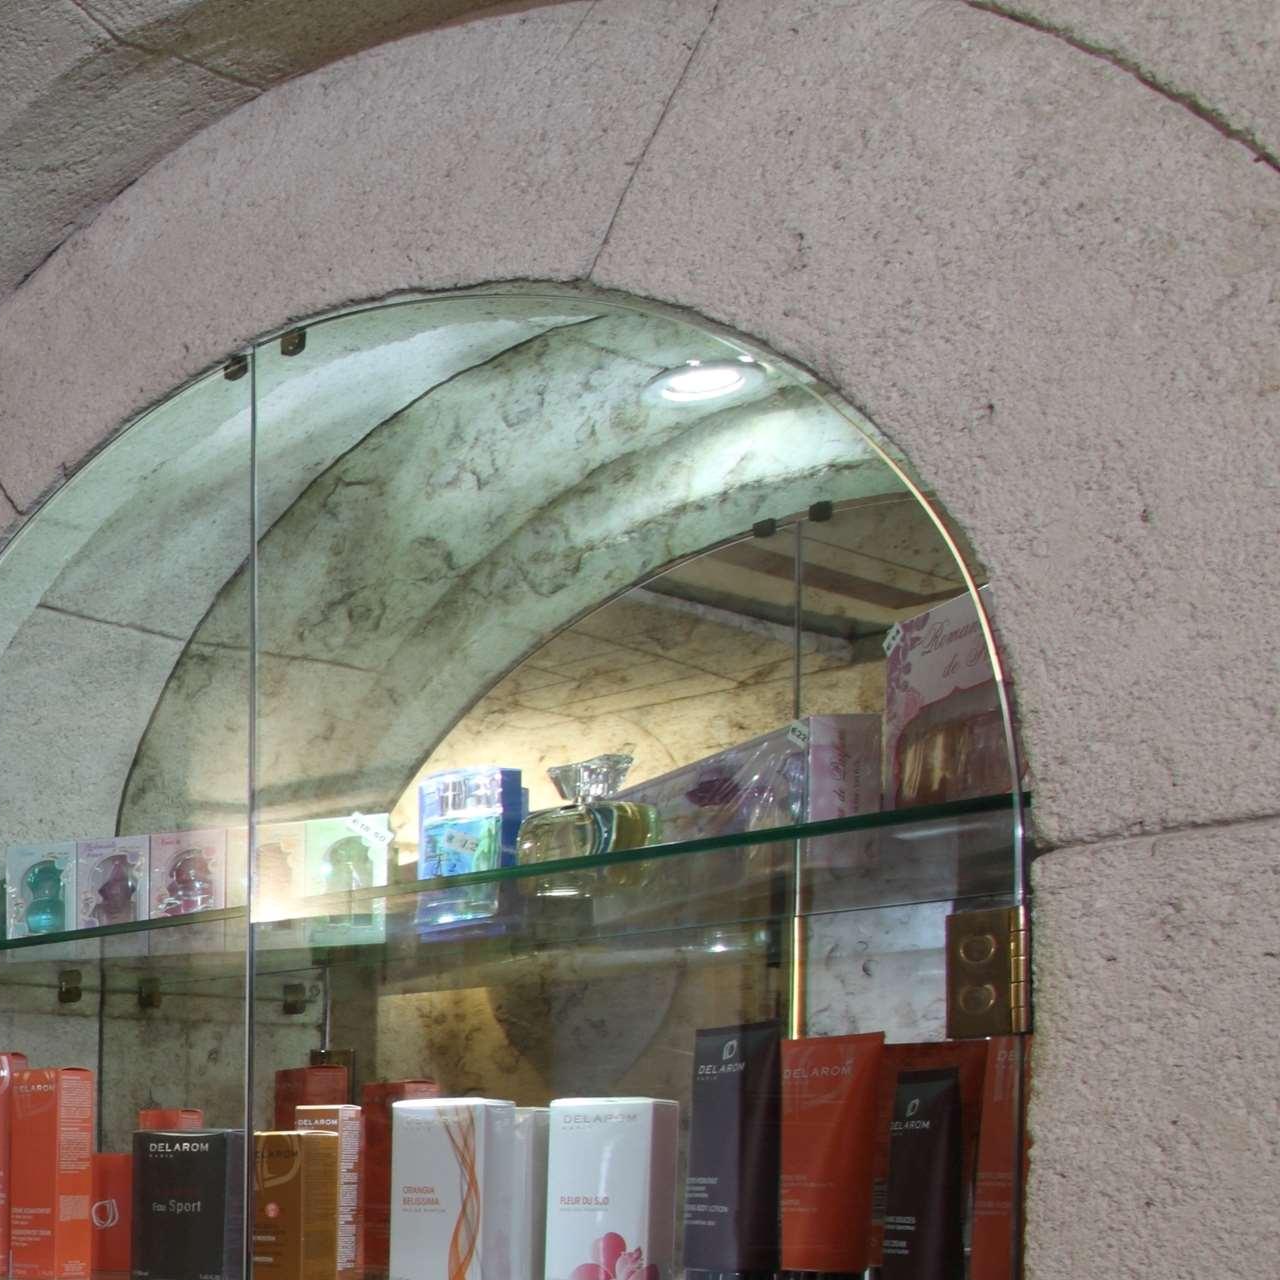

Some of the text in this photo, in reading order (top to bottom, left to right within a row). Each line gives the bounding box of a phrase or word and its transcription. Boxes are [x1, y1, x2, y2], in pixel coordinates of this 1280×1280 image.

[697, 1061, 745, 1075] DELAROM
[783, 1064, 852, 1079] DELAROM
[148, 1142, 209, 1153] DELAROM
[168, 1199, 201, 1215] Sport
